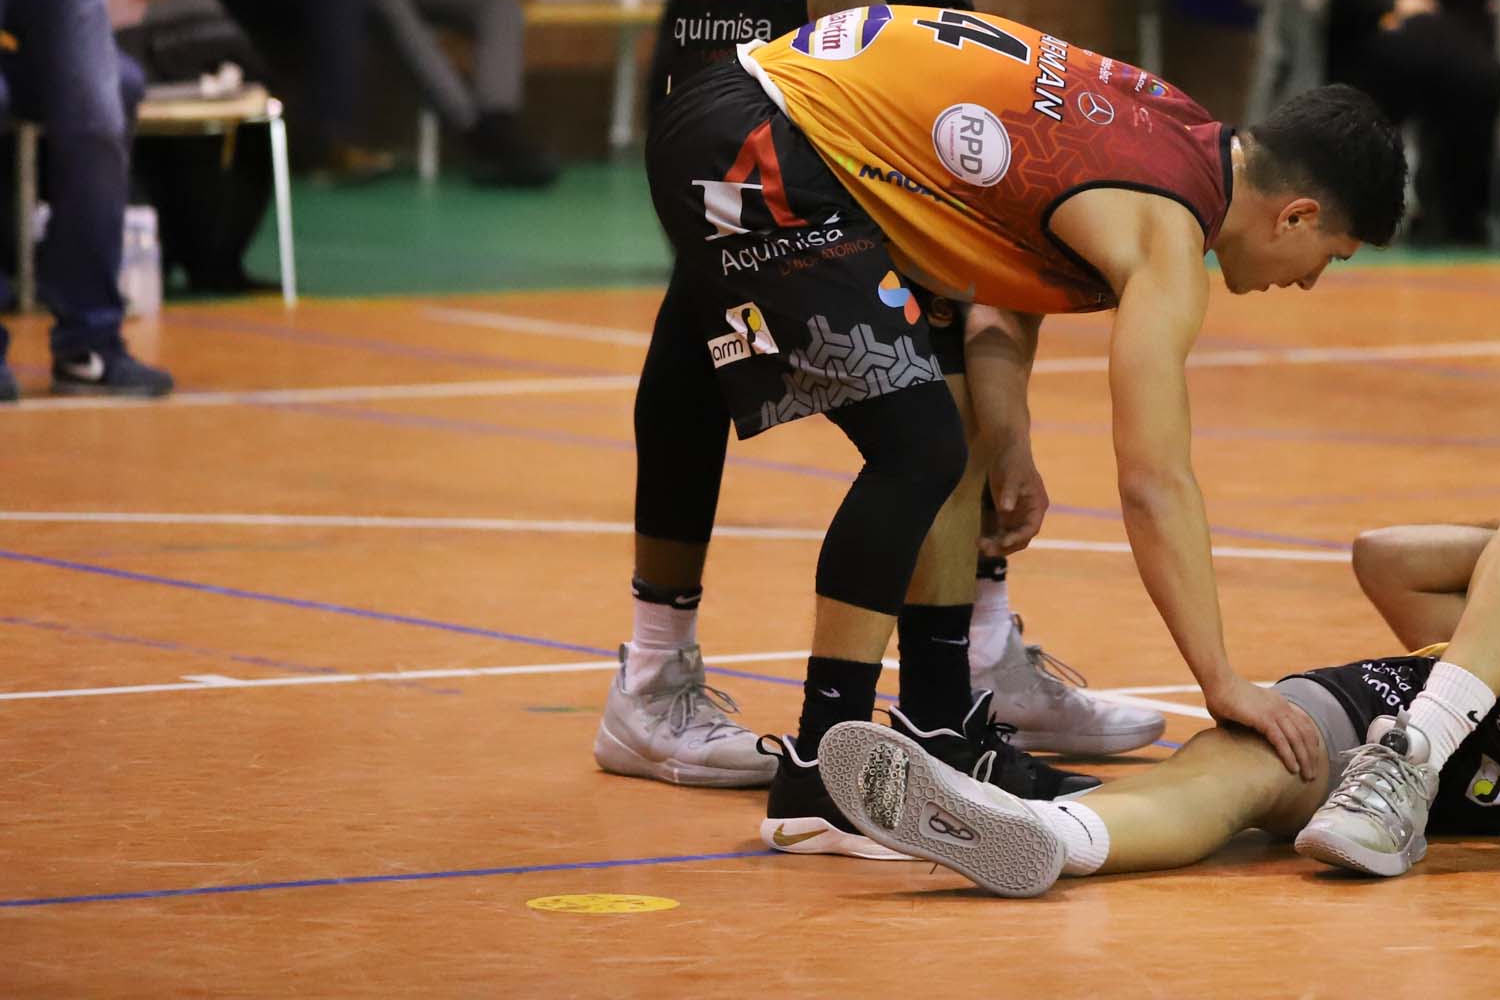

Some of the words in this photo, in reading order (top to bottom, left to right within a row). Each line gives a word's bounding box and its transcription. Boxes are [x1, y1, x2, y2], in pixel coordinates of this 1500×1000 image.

[674, 11, 773, 47] quimisa
[822, 8, 854, 51] artín
[912, 7, 1032, 65] 4
[958, 114, 985, 175] RPD
